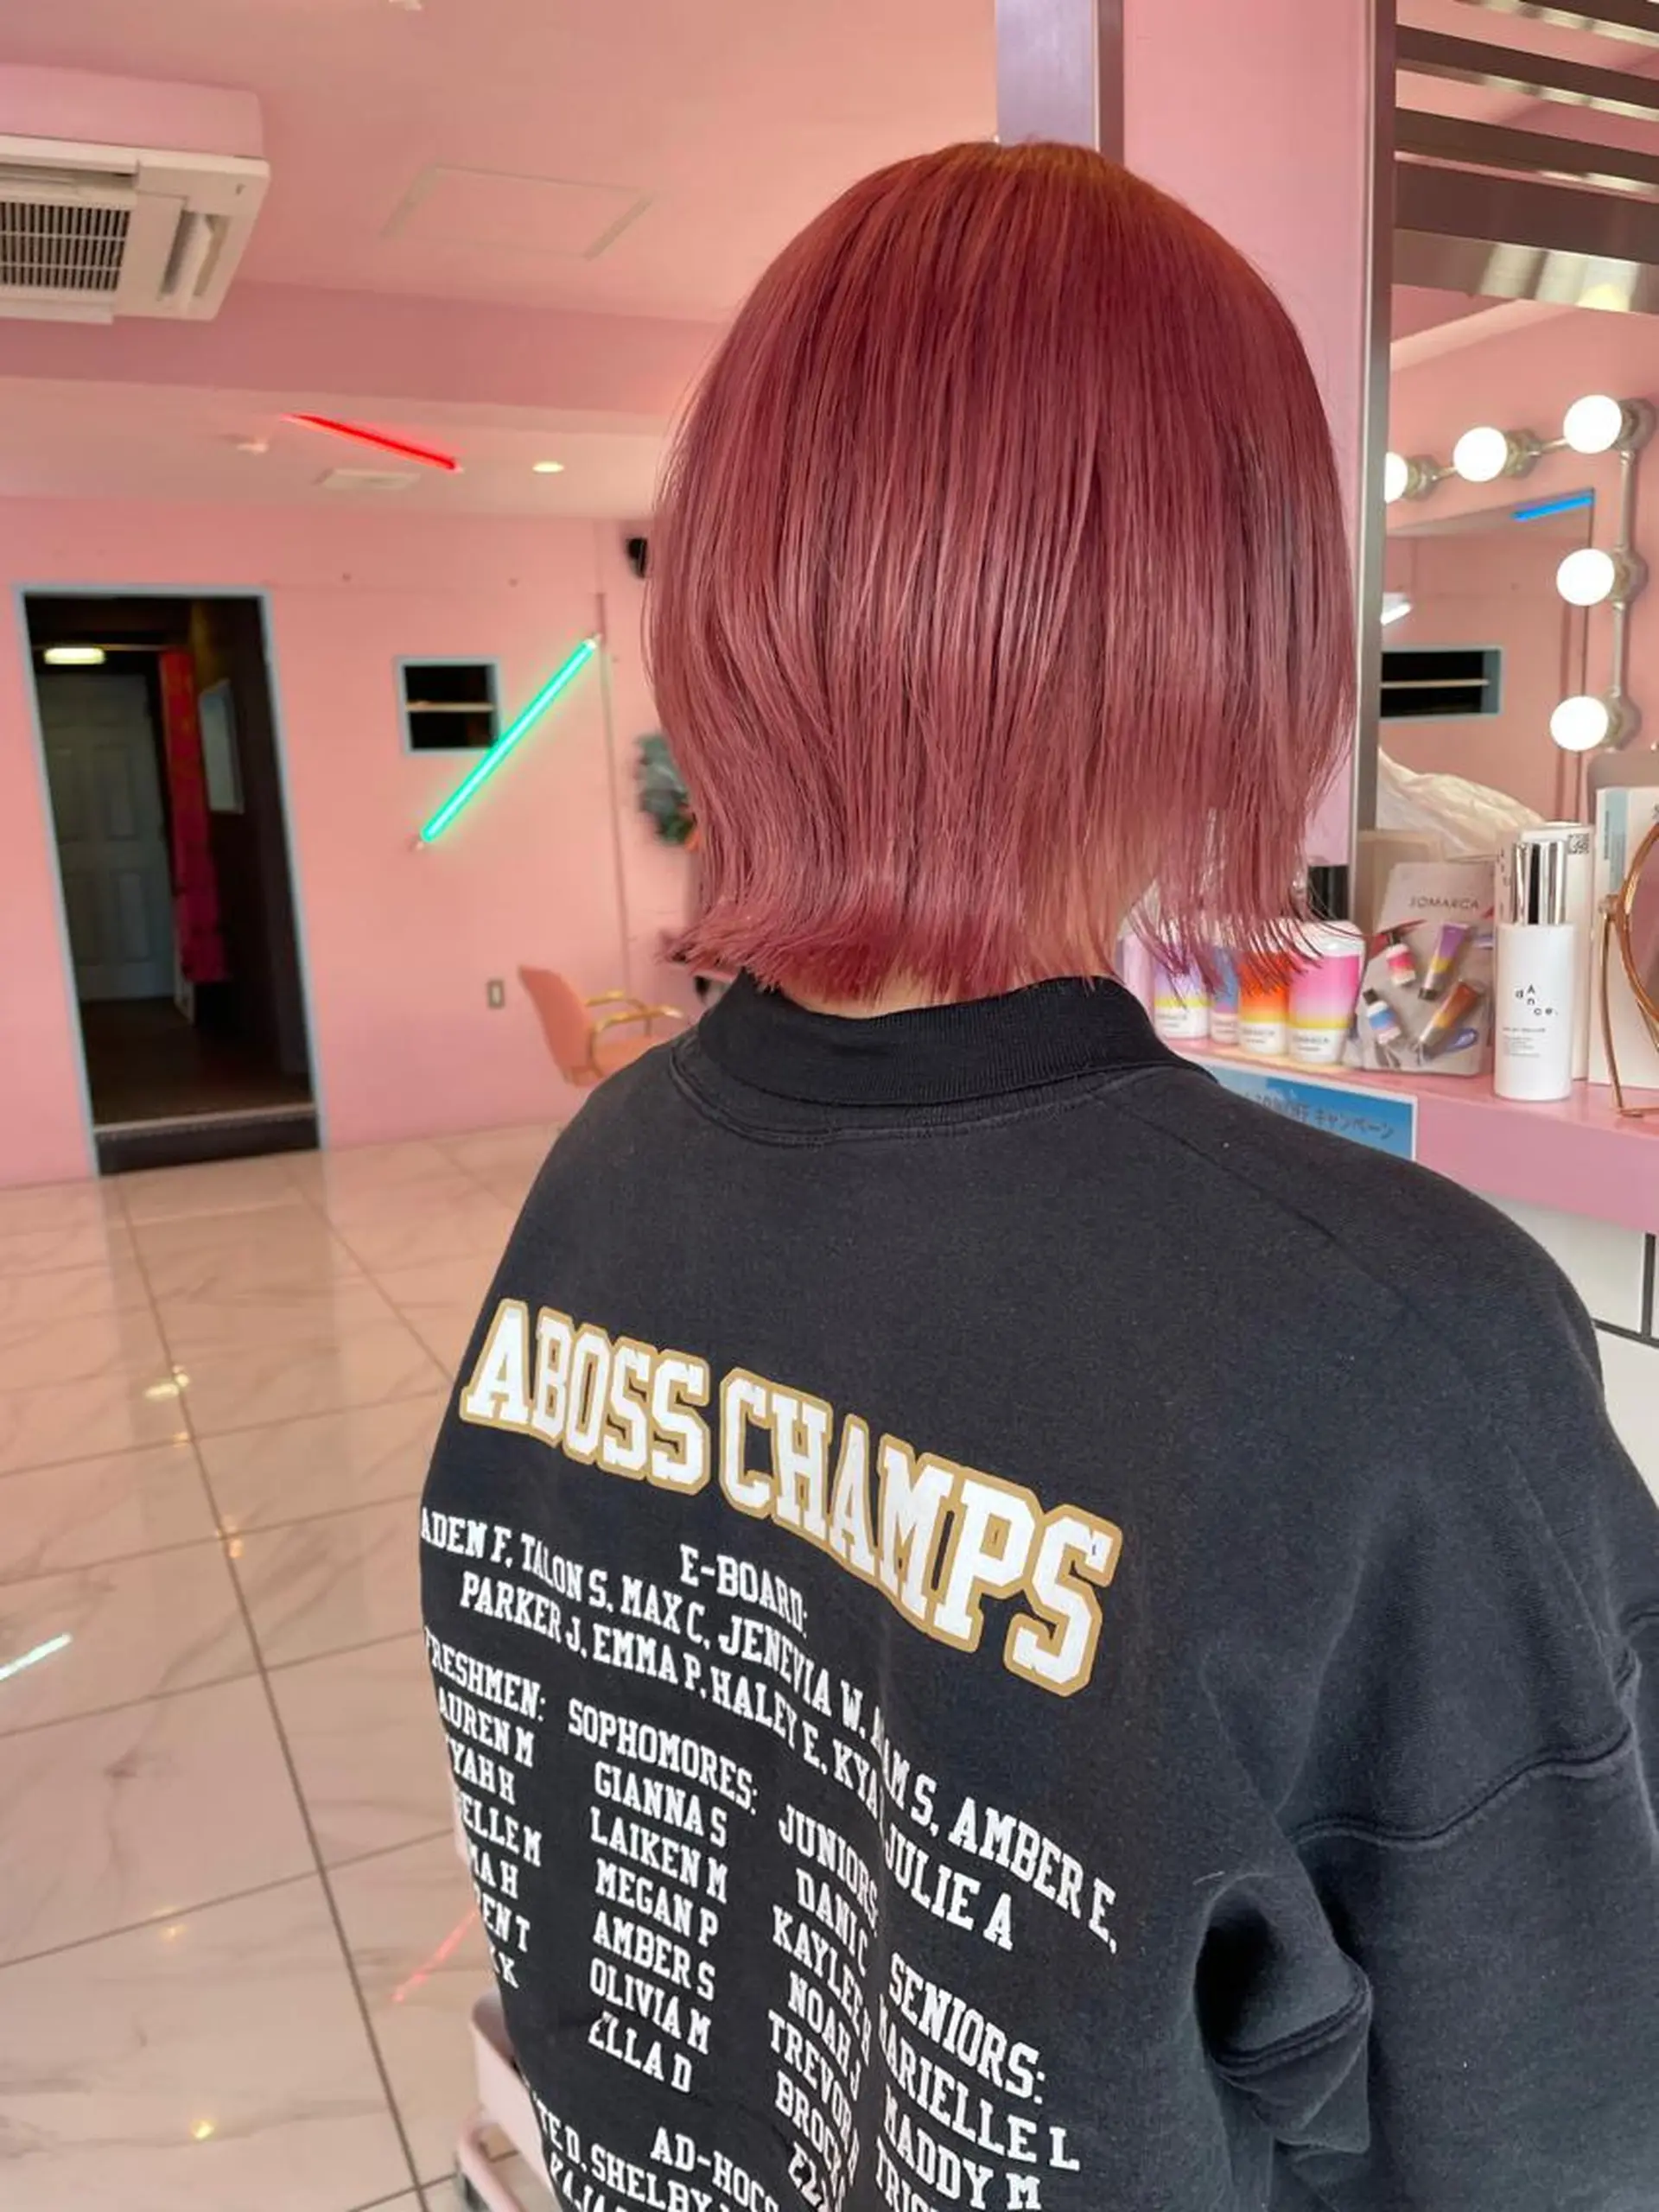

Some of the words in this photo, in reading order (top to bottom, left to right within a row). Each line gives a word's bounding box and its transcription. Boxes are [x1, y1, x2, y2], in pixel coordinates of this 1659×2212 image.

[460, 1298, 710, 1495] ABOSS
[719, 1367, 1122, 1697] CHAMPS
[680, 1544, 808, 1638] E-BOARD:
[460, 1571, 562, 1643] PARKER
[593, 1623, 679, 1684] EMMA
[710, 1666, 798, 1749] HALEY
[882, 1822, 981, 1930] JULIE
[983, 1893, 1013, 1950] A
[515, 1726, 534, 1768] M
[521, 1533, 583, 1602] TALON
[620, 1575, 683, 1634] MAX
[718, 1615, 832, 1717] JENEVIA
[948, 1797, 1084, 1918] AMBER
[569, 1698, 757, 1815] SOPHOMORES:
[499, 1766, 516, 1805] H
[595, 1761, 704, 1836] GIANNA
[710, 1807, 727, 1848] S
[500, 1860, 518, 1899] H
[524, 1826, 543, 1867] M
[591, 1806, 701, 1888] LAIKEN
[707, 1857, 728, 1904] M
[516, 1916, 531, 1952] T
[595, 1858, 693, 1936] MEGAN
[698, 1908, 719, 1948] P
[593, 1910, 691, 1988] AMBER
[697, 1961, 715, 2001] S
[590, 1958, 681, 2039] OLIVIA
[688, 2008, 711, 2054] M
[788, 1971, 851, 2076] NOAH
[889, 1953, 1046, 2104] SENIORS:
[671, 2053, 691, 2092] D
[768, 2010, 852, 2152] TREVOR
[884, 2084, 994, 2209] MADDY
[1006, 2173, 1042, 2210] M
[1050, 2126, 1079, 2171] L
